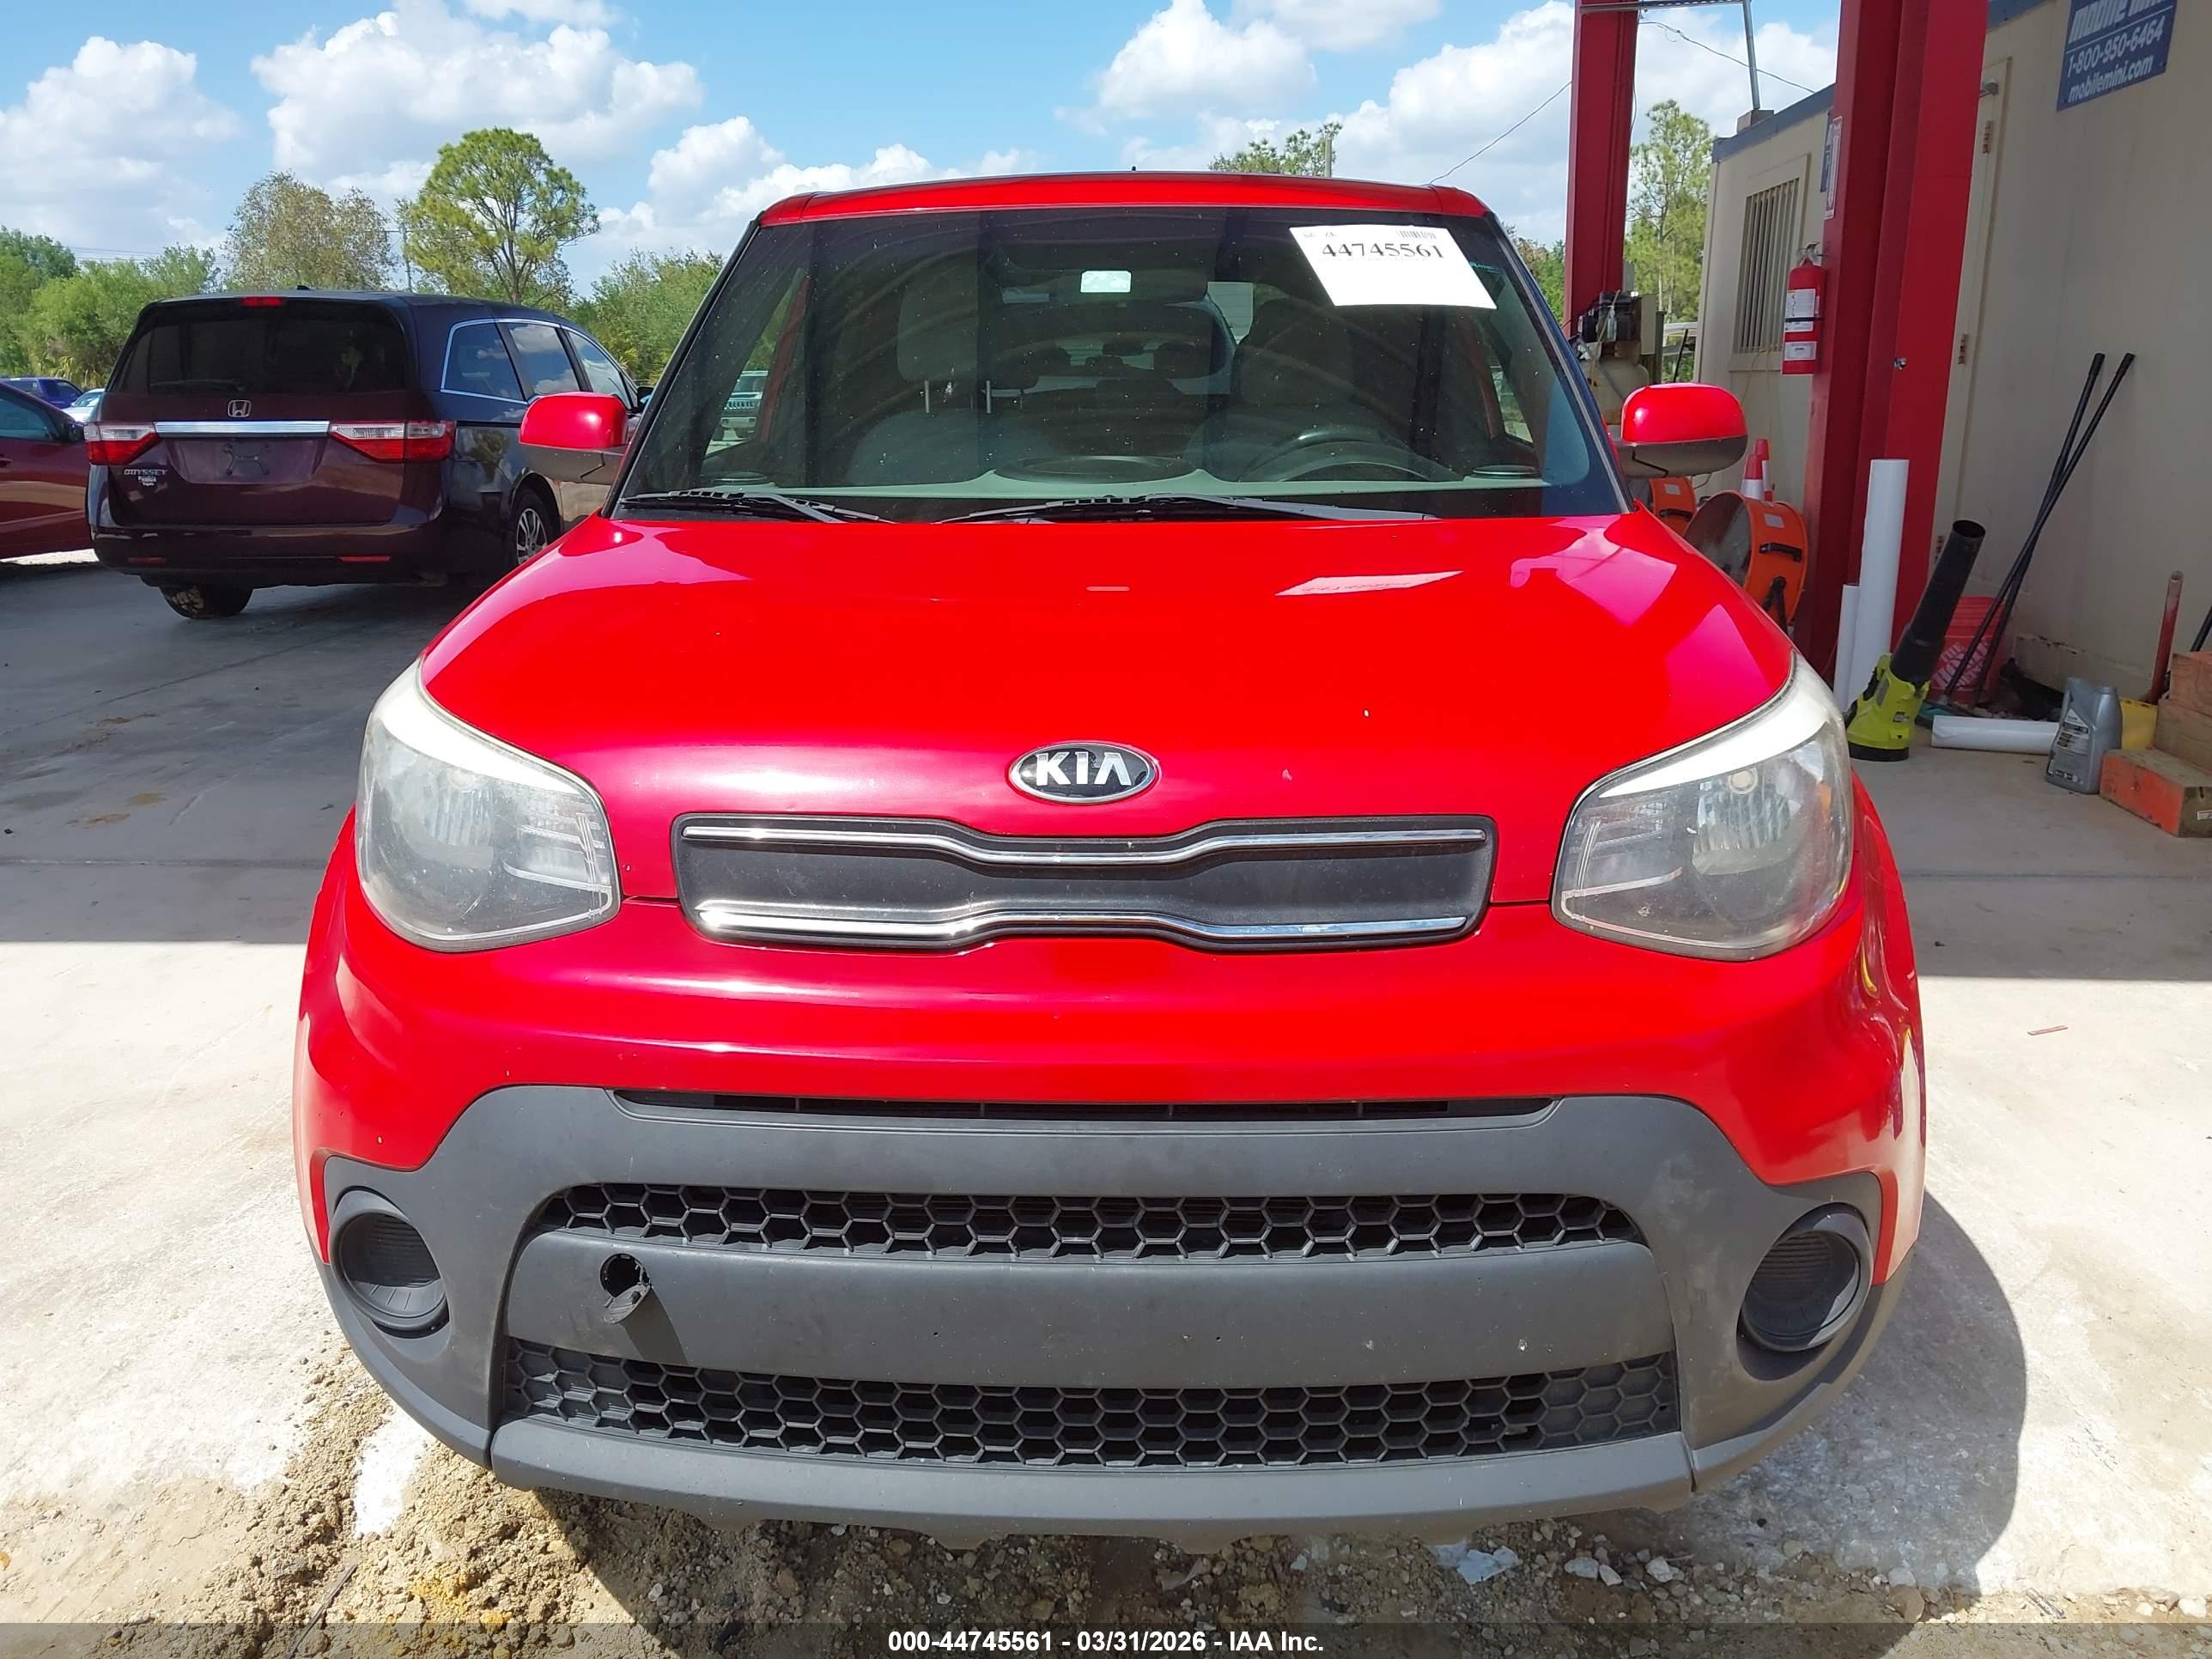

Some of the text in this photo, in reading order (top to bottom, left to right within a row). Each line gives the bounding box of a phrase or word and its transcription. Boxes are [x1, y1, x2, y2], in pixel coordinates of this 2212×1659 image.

[2067, 15, 2166, 78] 1-800-950-6464
[2067, 55, 2154, 104] mobilemini.com
[1322, 242, 1444, 258] 44745561
[1036, 751, 1133, 787] KIA
